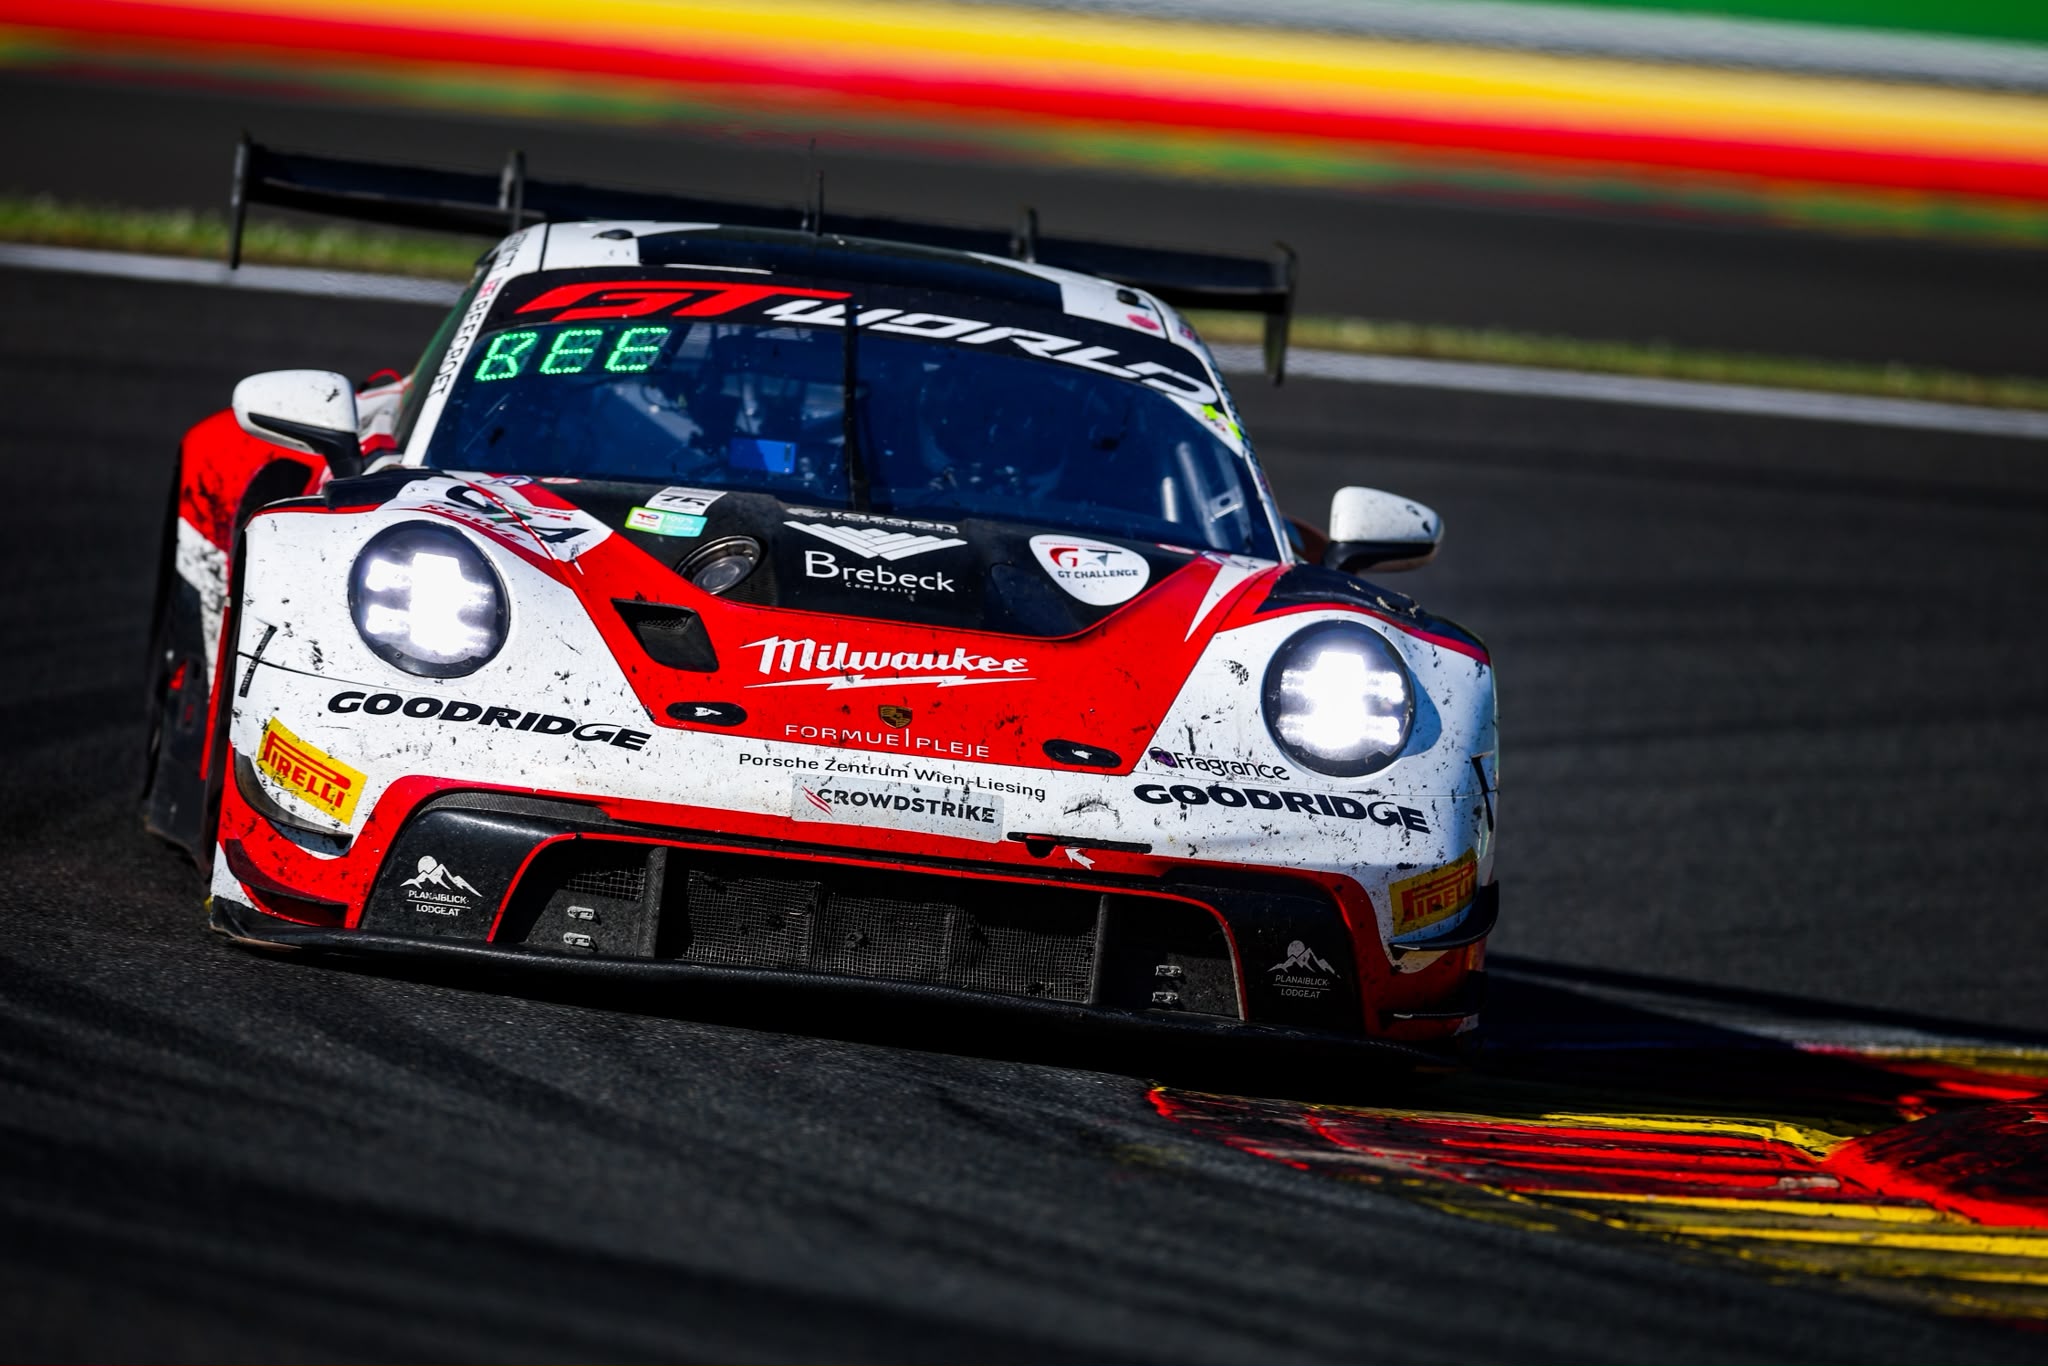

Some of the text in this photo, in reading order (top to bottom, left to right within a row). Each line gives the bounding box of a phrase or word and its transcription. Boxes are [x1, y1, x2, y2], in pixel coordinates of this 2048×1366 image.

[514, 280, 1218, 404] GT WORLD
[805, 550, 955, 592] Brebeck
[1058, 569, 1139, 579] GT CHALLENGE
[327, 691, 651, 751] GOODRIDGE
[263, 730, 351, 808] PIRELLI
[739, 753, 819, 769] Porsche
[825, 758, 908, 778] Zentrum
[1173, 752, 1290, 780] Fragrance
[816, 788, 996, 824] CROWDSTRIKE
[1133, 784, 1431, 834] GOODRIDGE
